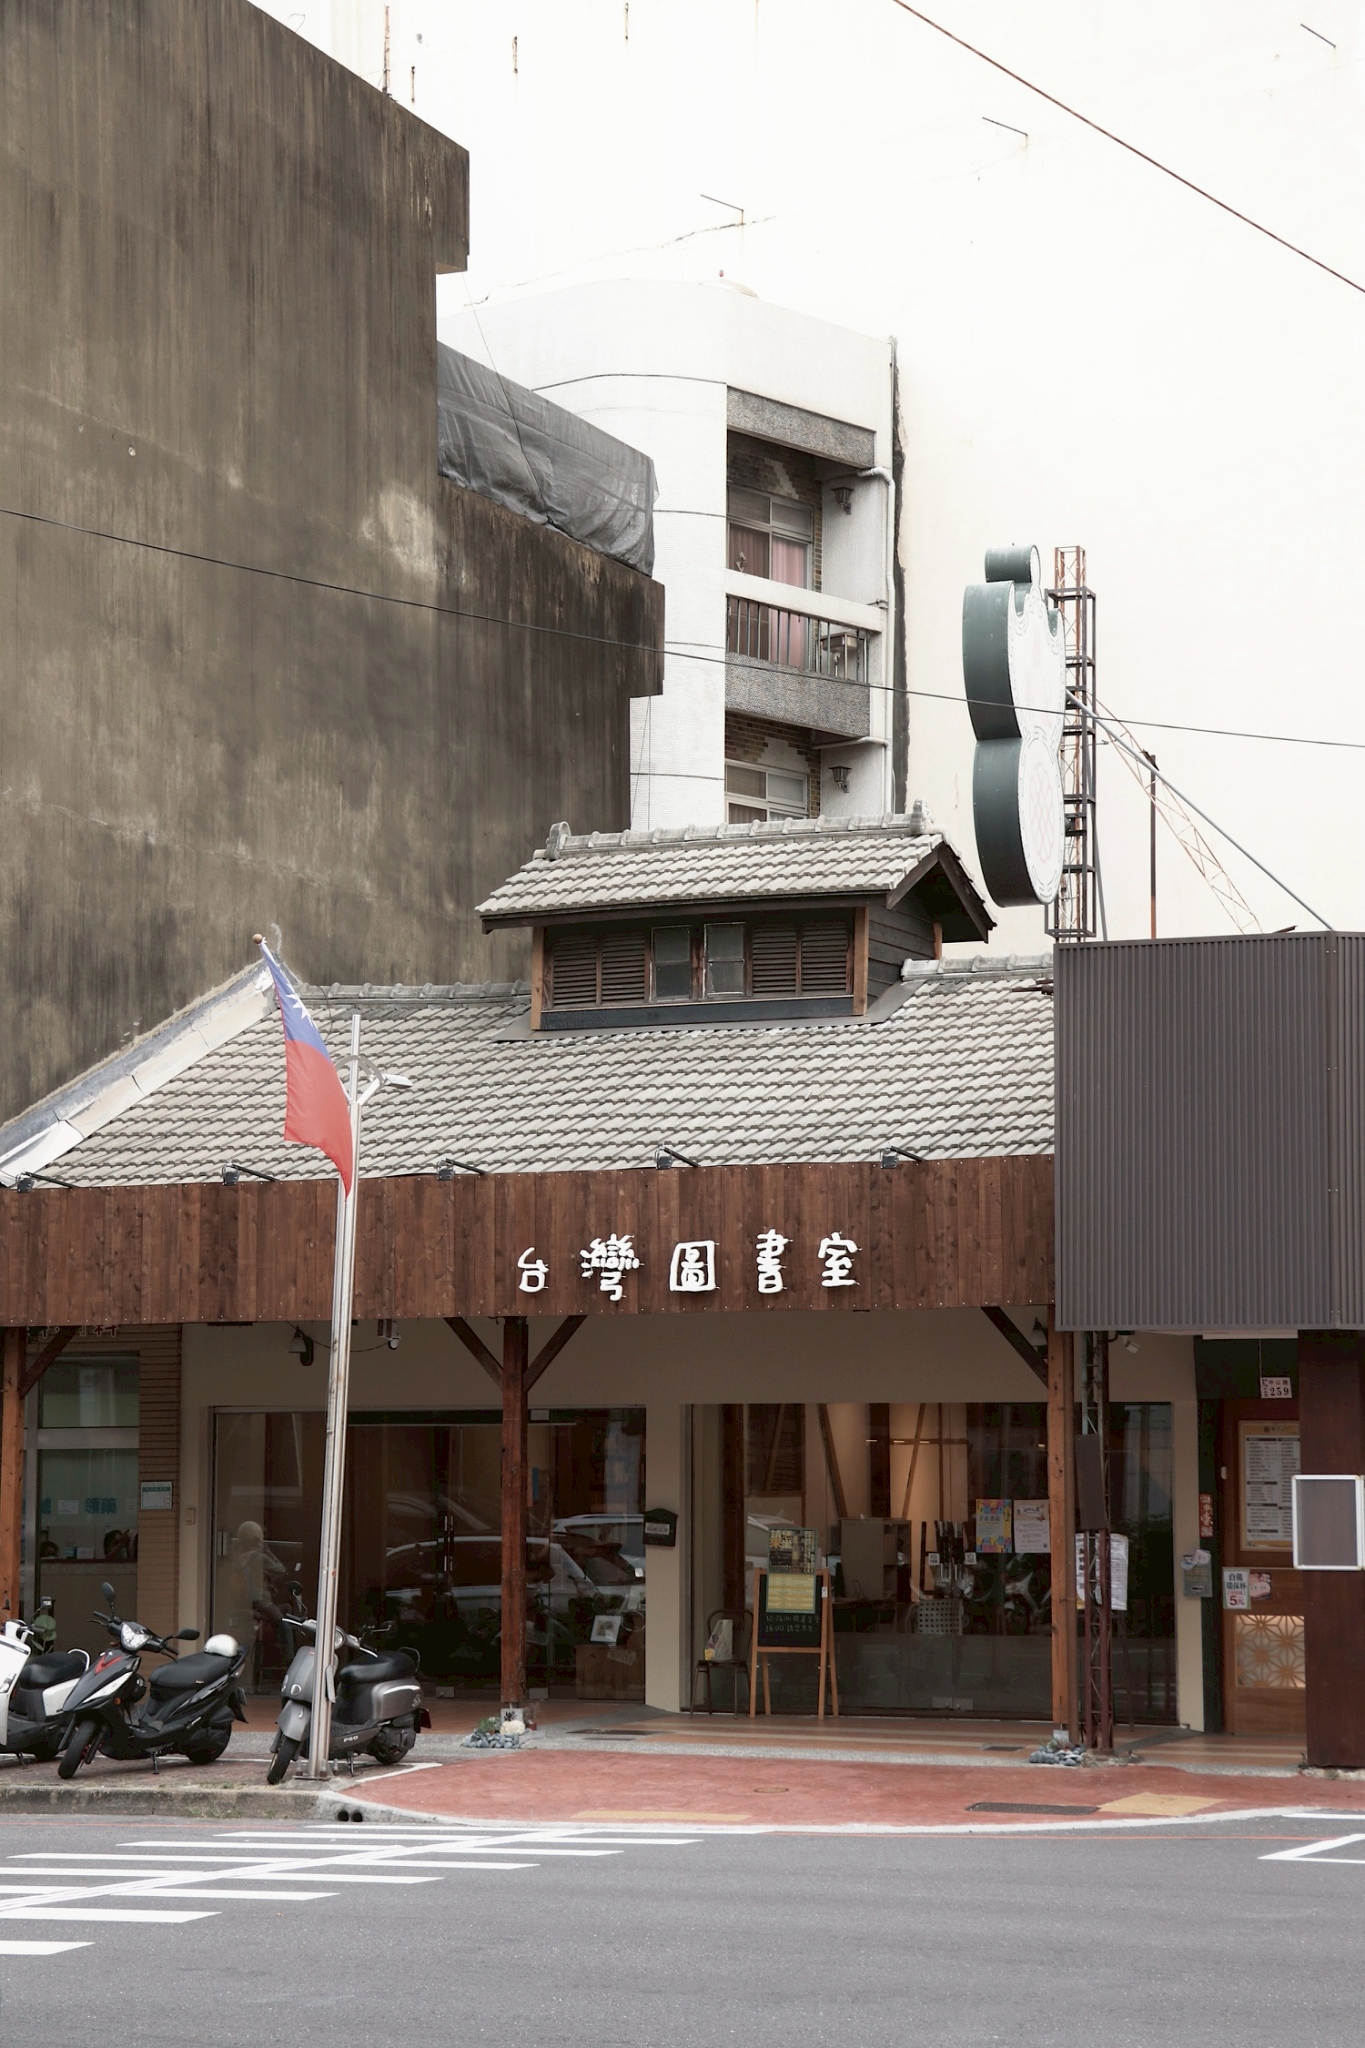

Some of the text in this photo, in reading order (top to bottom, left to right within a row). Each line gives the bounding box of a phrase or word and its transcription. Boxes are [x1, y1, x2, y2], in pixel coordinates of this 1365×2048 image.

[518, 1229, 859, 1301] 台灣圖書室
[1269, 1387, 1289, 1396] 259
[85, 1497, 117, 1514] 領藥
[1229, 1596, 1245, 1606] 5元
